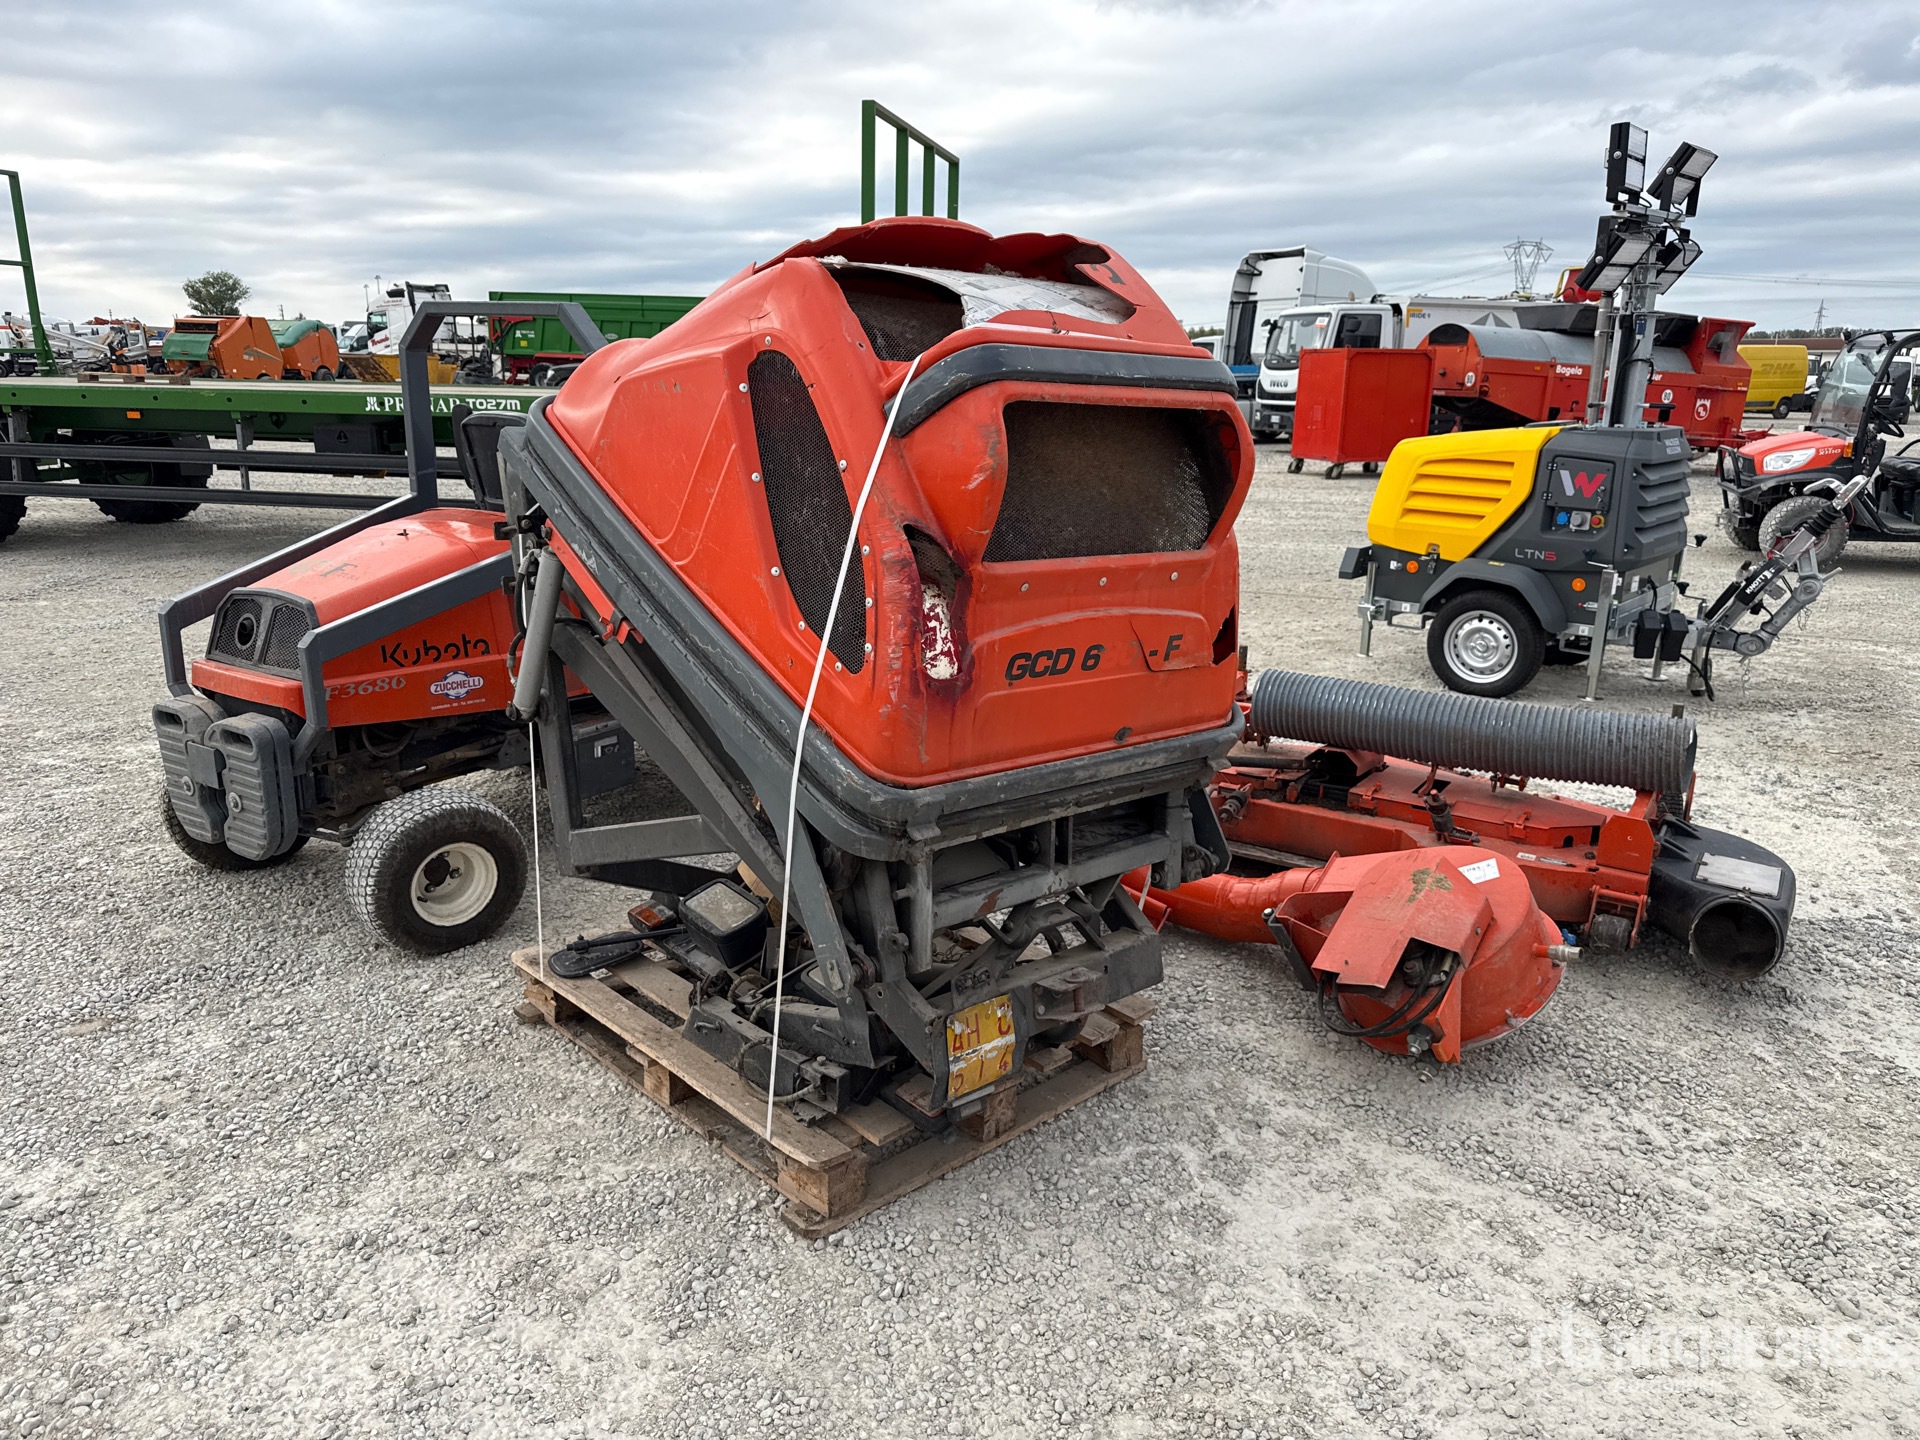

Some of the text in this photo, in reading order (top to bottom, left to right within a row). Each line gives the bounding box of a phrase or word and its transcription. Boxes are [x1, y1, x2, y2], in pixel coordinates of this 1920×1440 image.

[1556, 364, 1583, 376] Bagela
[1270, 380, 1288, 388] IVECO
[1745, 574, 1765, 595] KNOTT
[381, 634, 491, 668] Kubota
[1005, 647, 1076, 681] GCD
[326, 675, 407, 701] F3680
[433, 677, 481, 693] ZUCCHELLI
